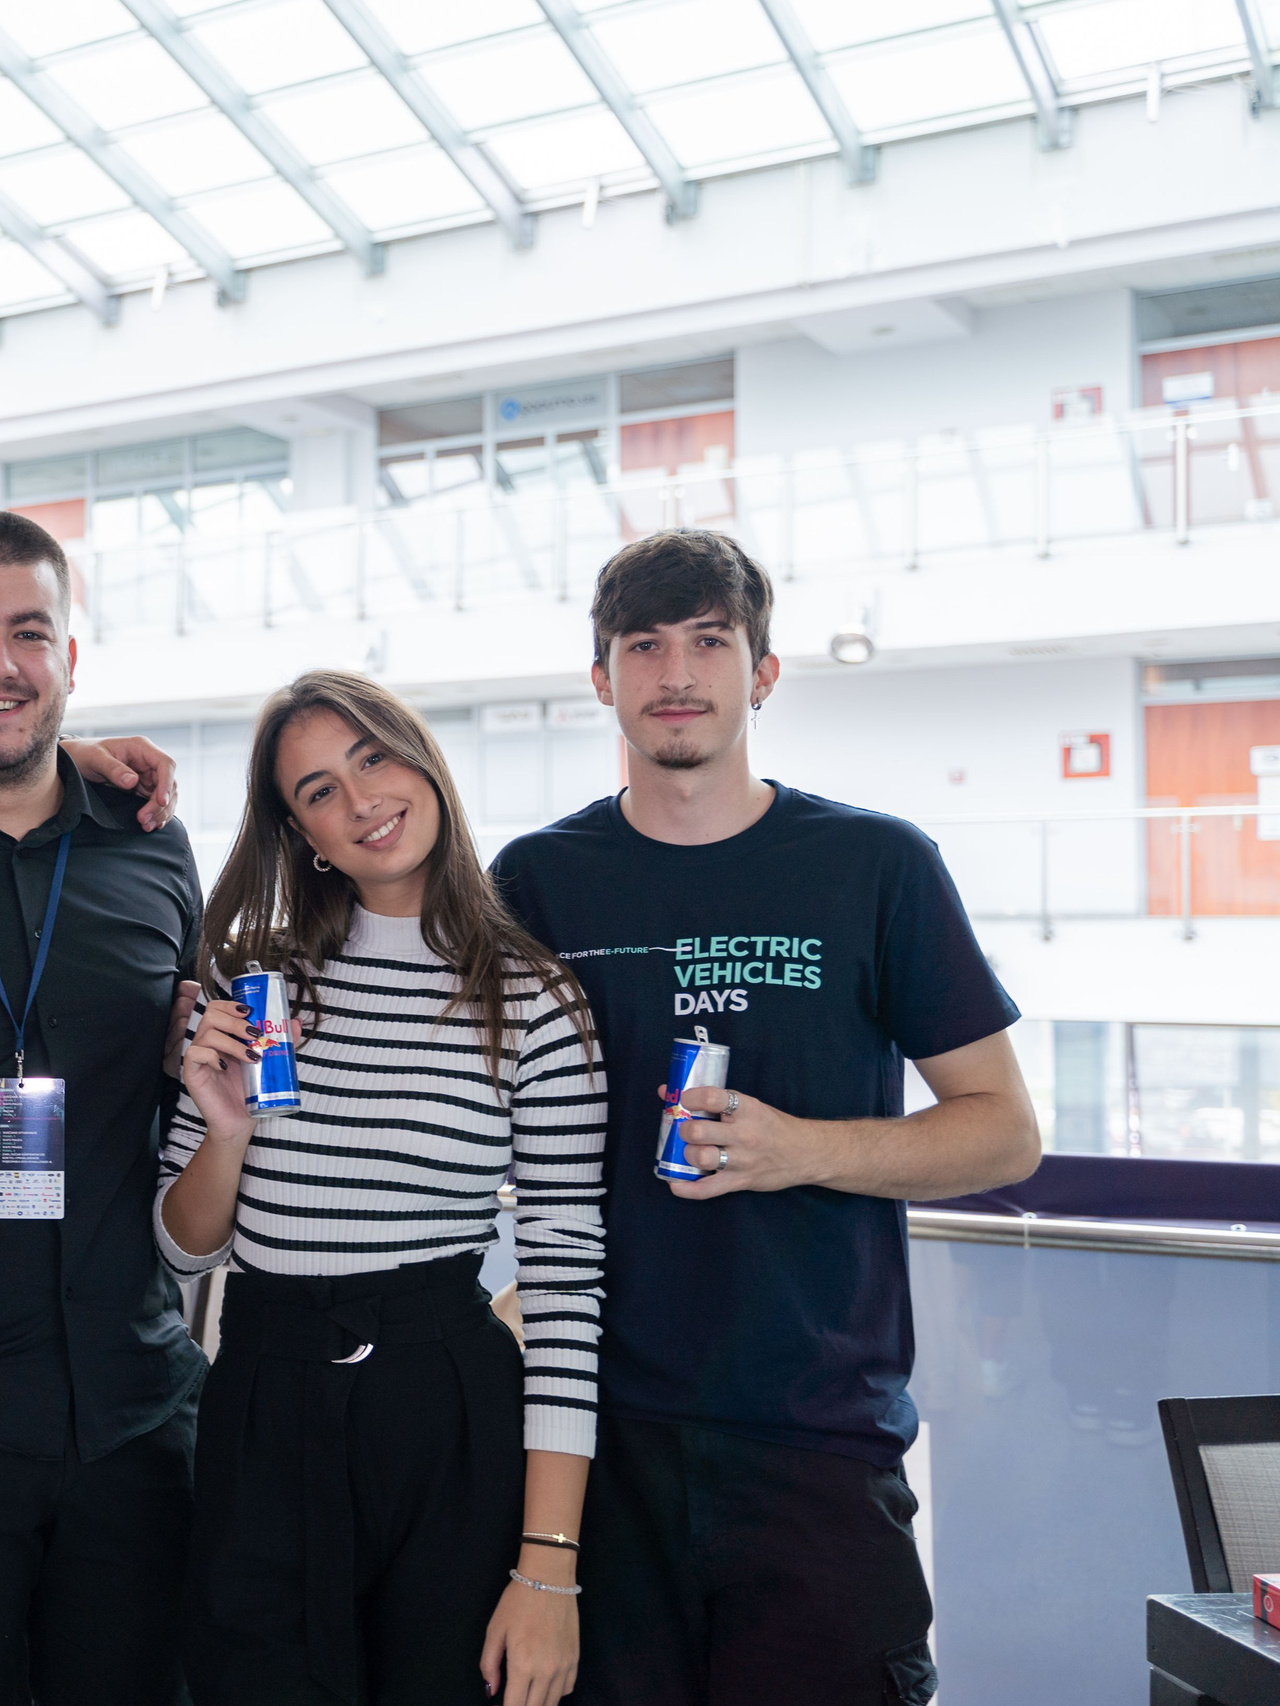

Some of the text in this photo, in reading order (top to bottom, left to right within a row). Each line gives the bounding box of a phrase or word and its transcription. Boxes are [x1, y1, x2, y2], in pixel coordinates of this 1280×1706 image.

[571, 950, 589, 960] FOR
[605, 946, 649, 955] E-FUTURE
[675, 936, 822, 961] ELECTRIC
[674, 961, 821, 989] VEHICLES
[674, 988, 748, 1016] DAYS
[263, 1018, 289, 1034] Bull
